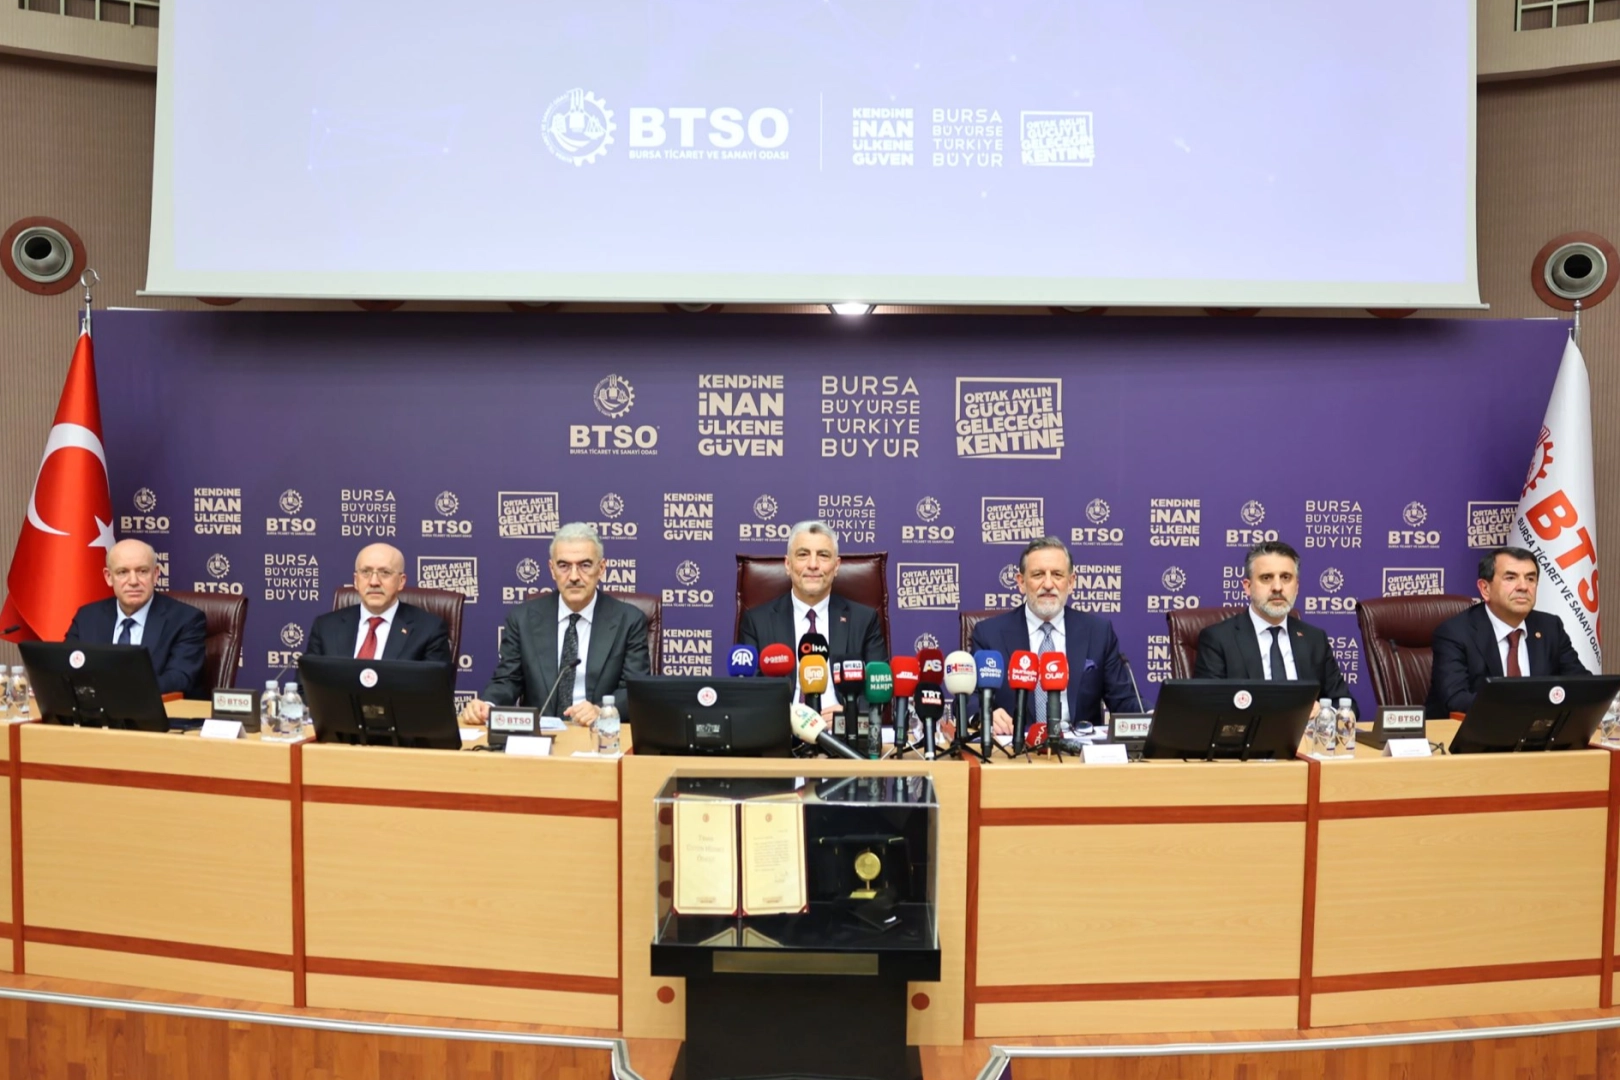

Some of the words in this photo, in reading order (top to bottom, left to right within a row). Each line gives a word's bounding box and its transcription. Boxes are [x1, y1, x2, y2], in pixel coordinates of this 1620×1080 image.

[933, 108, 1003, 123] BURSA
[629, 108, 789, 148] BTSO
[933, 125, 1003, 136] BÜYÜRSE
[853, 140, 914, 151] ÜLKENE
[933, 138, 1003, 151] TÜRKİYE
[629, 150, 661, 160] BURSA
[663, 150, 704, 160] TİCARET
[707, 150, 719, 160] VE
[722, 150, 757, 160] SANAYİ
[760, 150, 789, 160] ODASI
[853, 153, 914, 166] GÜVEN
[933, 153, 1003, 167] BÜYÜR
[822, 375, 919, 395] BURSA
[964, 390, 1009, 403] ORTAK
[1011, 386, 1052, 399] AKLIN
[822, 400, 919, 415] BÜYÜRSE
[698, 420, 783, 435] ÜLKENE
[822, 418, 919, 434] TÜRKİYE
[570, 425, 658, 448] BTSO
[698, 438, 783, 457] GÜVEN
[822, 438, 919, 457] BÜYÜR
[341, 490, 396, 501] BURSA
[818, 495, 875, 506] BURSA
[341, 503, 396, 512] BÜYÜRSE
[986, 504, 1012, 512] ORTAK
[1305, 500, 1362, 512] BURSA
[194, 513, 241, 523] ÜLKENE
[341, 513, 396, 523] TÜRKİYE
[818, 509, 876, 518] BÜYÜRSE
[1305, 514, 1362, 523] BÜYÜRSE
[121, 516, 170, 530] BTSO
[266, 518, 316, 532] BTSO
[421, 520, 472, 534] BTSO
[663, 519, 713, 529] ÜLKENE
[194, 524, 241, 535] GÜVEN
[341, 525, 396, 537] BÜYÜR
[663, 530, 713, 541] GÜVEN
[739, 524, 791, 538] BTSO
[902, 526, 954, 540] BTSO
[1071, 528, 1123, 542] BTSO
[1150, 525, 1200, 535] ÜLKENE
[1305, 525, 1362, 535] TÜRKİYE
[1150, 536, 1200, 546] GÜVEN
[1226, 530, 1278, 543] BTSO
[1305, 536, 1362, 548] BÜYÜR
[1388, 531, 1440, 545] BTSO
[264, 554, 319, 566] BURSA
[264, 567, 319, 577] BÜYÜRSE
[422, 564, 448, 572] ORTAK
[902, 569, 928, 578] ORTAK
[264, 578, 319, 588] TÜRKİYE
[1517, 517, 1535, 549] BURSA
[1532, 546, 1564, 587] TİCARET
[1560, 586, 1574, 601] VE
[1569, 600, 1594, 637] SANAYİ
[264, 589, 319, 601] BÜYÜR
[662, 589, 713, 603] BTSO
[985, 593, 1026, 607] BTS
[1071, 591, 1121, 601] ÜLKENE
[1071, 602, 1120, 612] GÜVEN
[1147, 595, 1199, 609] BTSO
[1305, 597, 1357, 611] BTSO
[1328, 636, 1358, 649] RSA
[267, 651, 303, 664] BTS
[663, 655, 712, 664] ÜLKENE
[663, 665, 712, 676] GÜVEN
[923, 660, 942, 673] AS
[922, 690, 941, 699] TRT
[227, 698, 249, 706] BTSO
